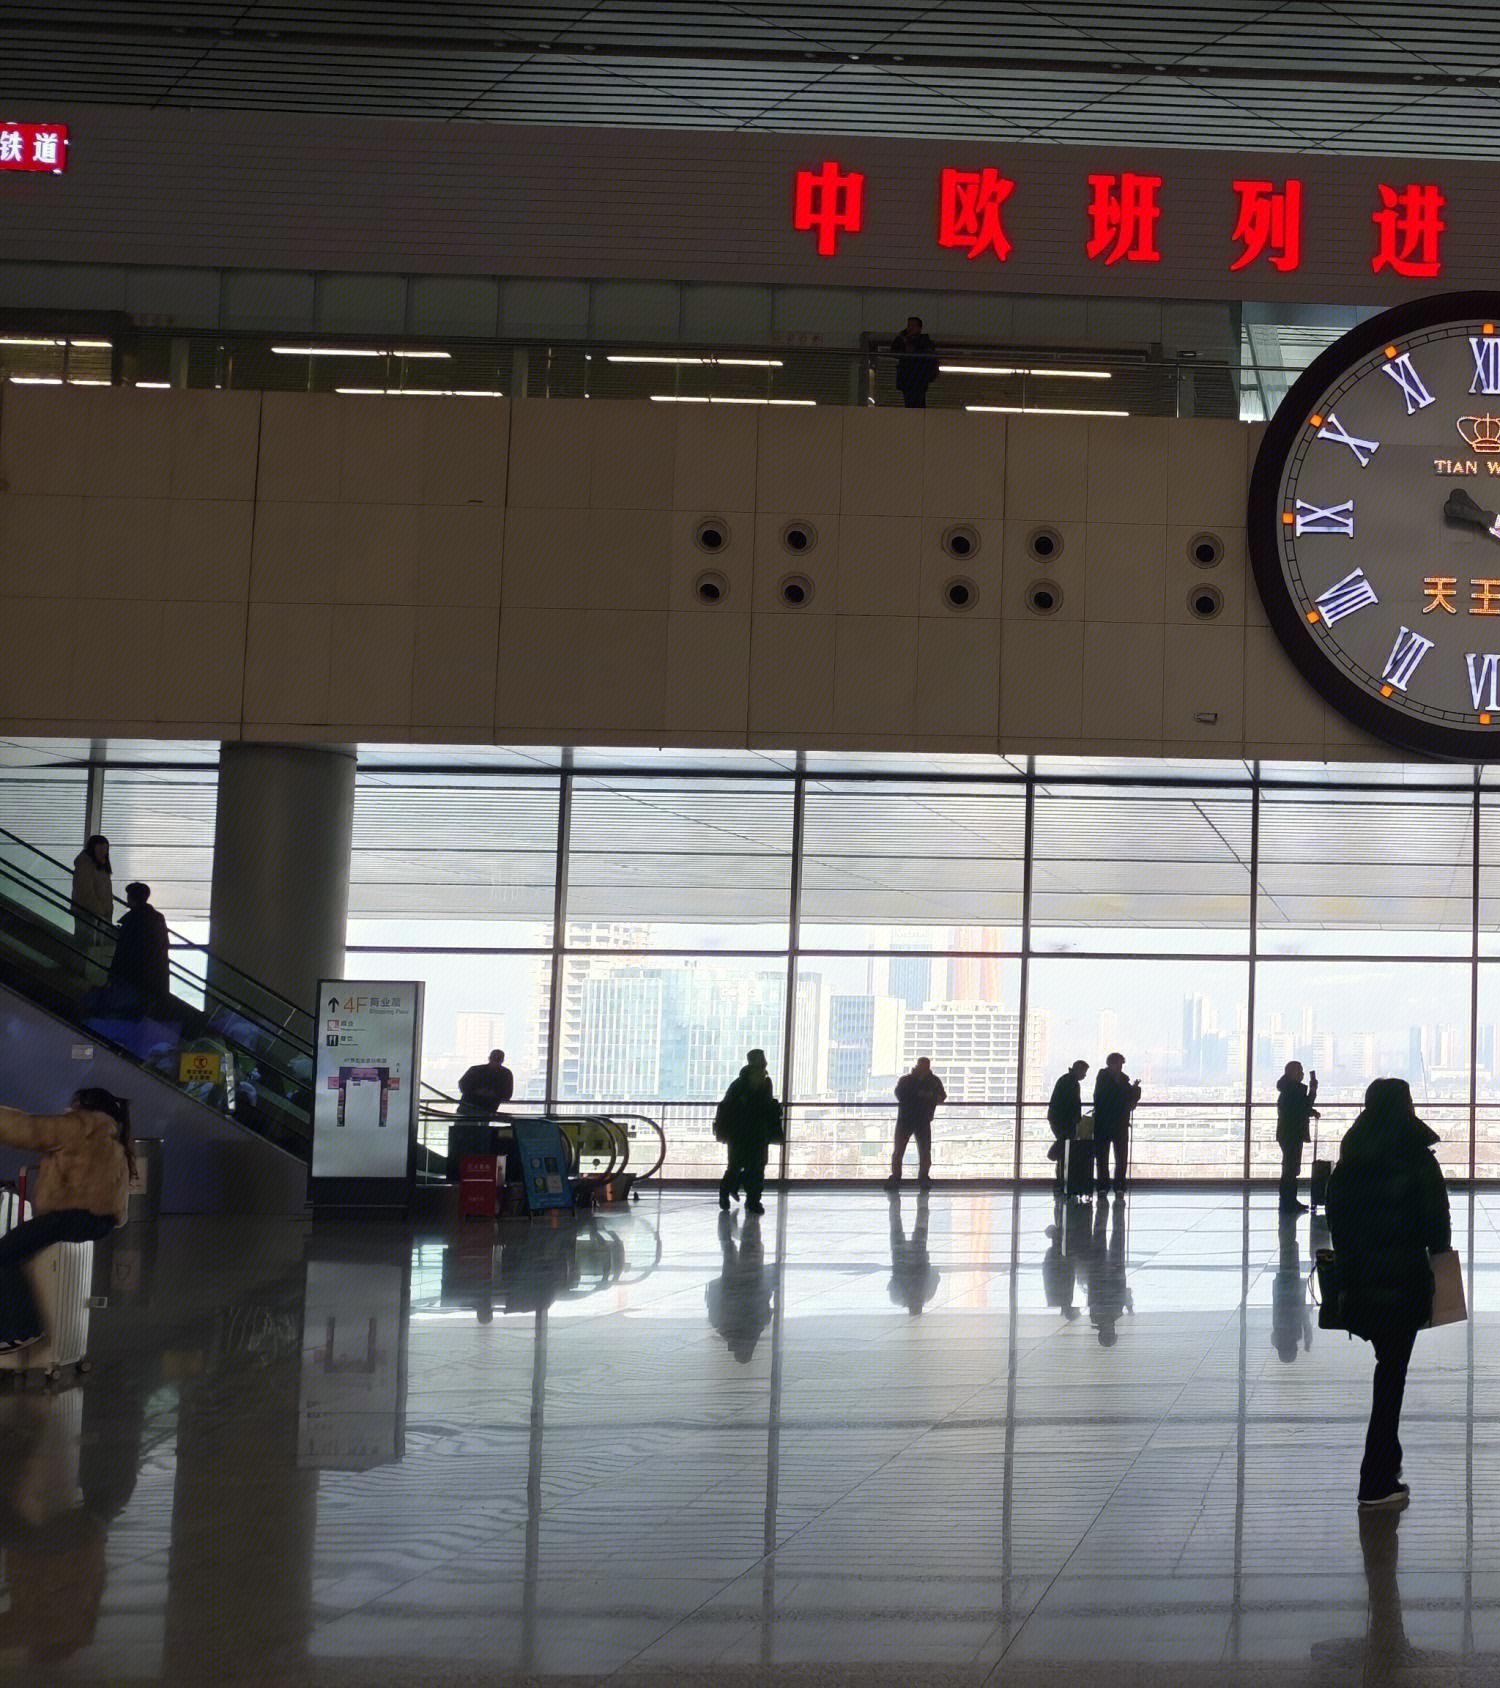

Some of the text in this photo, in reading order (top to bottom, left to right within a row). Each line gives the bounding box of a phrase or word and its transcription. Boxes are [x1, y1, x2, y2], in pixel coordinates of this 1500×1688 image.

[0, 130, 59, 164] 铁道
[1433, 459, 1478, 475] TIAN
[344, 996, 368, 1014] 4F
